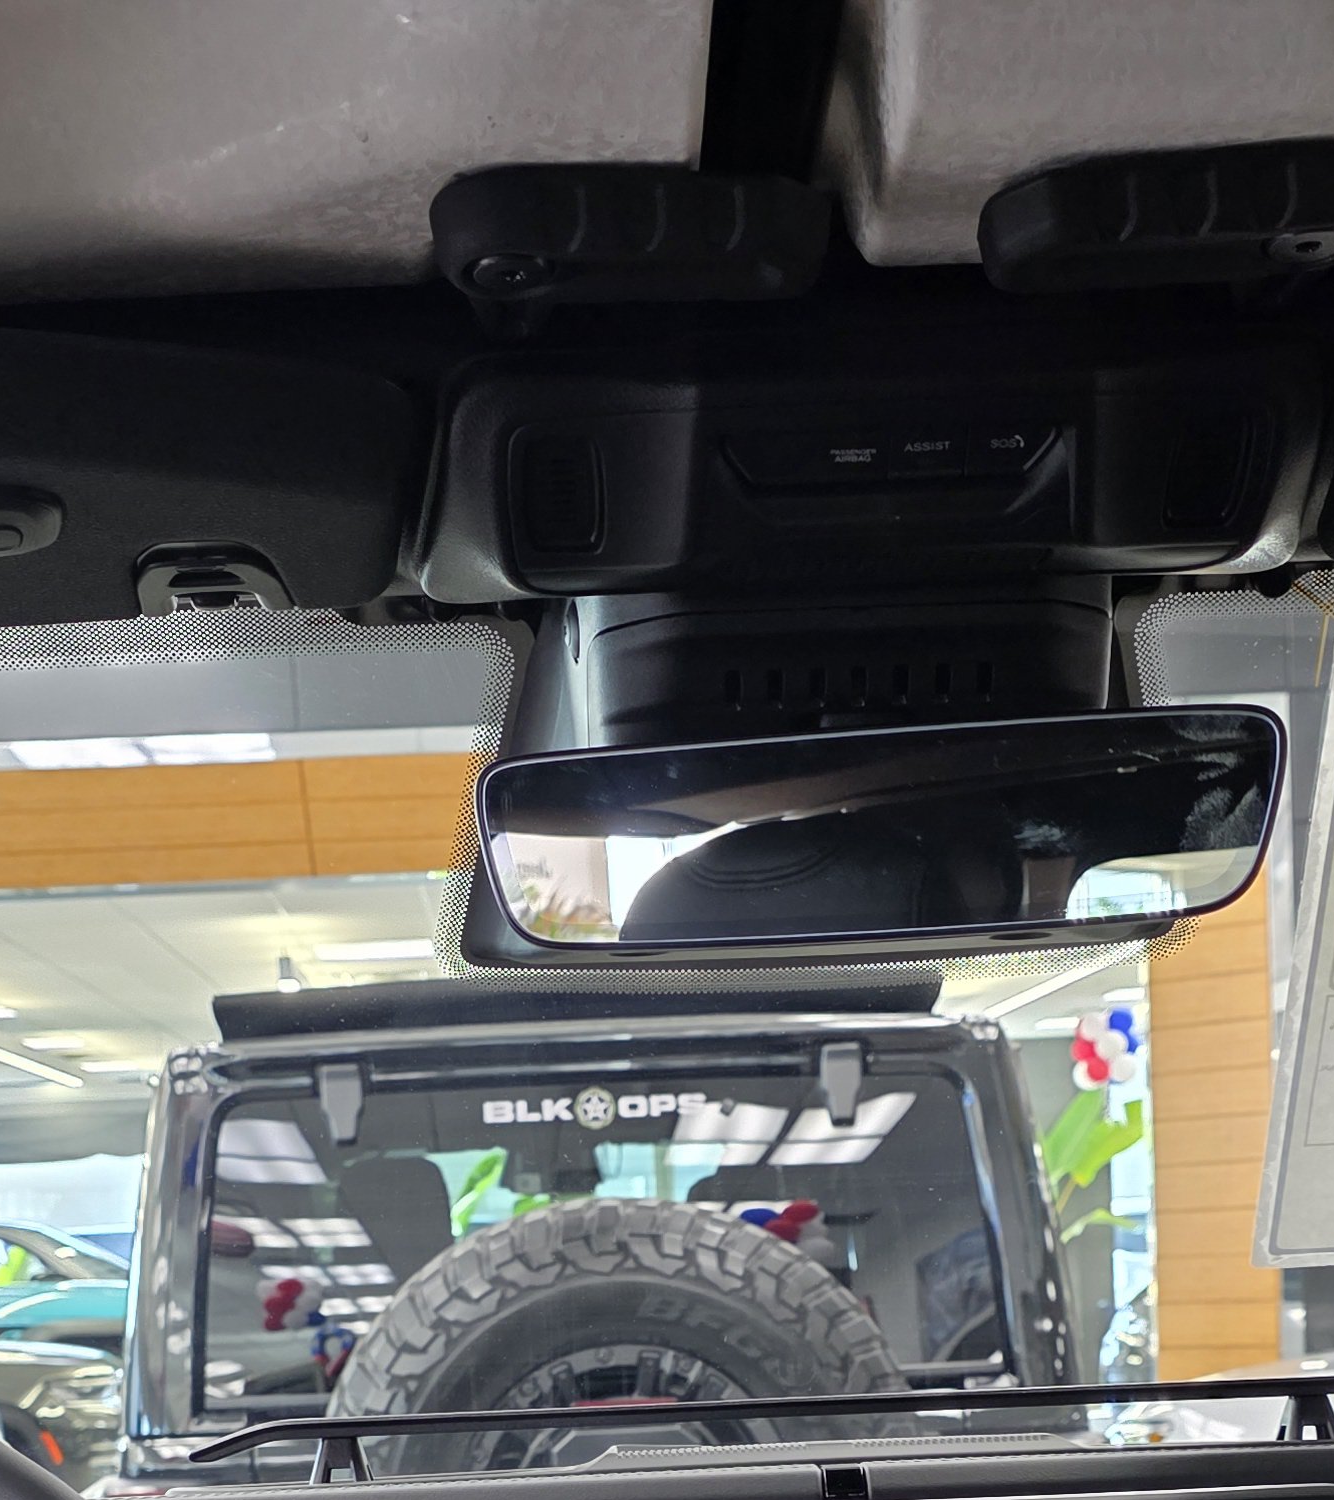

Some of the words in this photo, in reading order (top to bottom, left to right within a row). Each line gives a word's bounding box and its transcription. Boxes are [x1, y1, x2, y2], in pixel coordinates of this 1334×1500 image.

[904, 441, 951, 452] ASSIST
[990, 438, 1017, 449] SOS
[834, 455, 872, 463] AIRBAG
